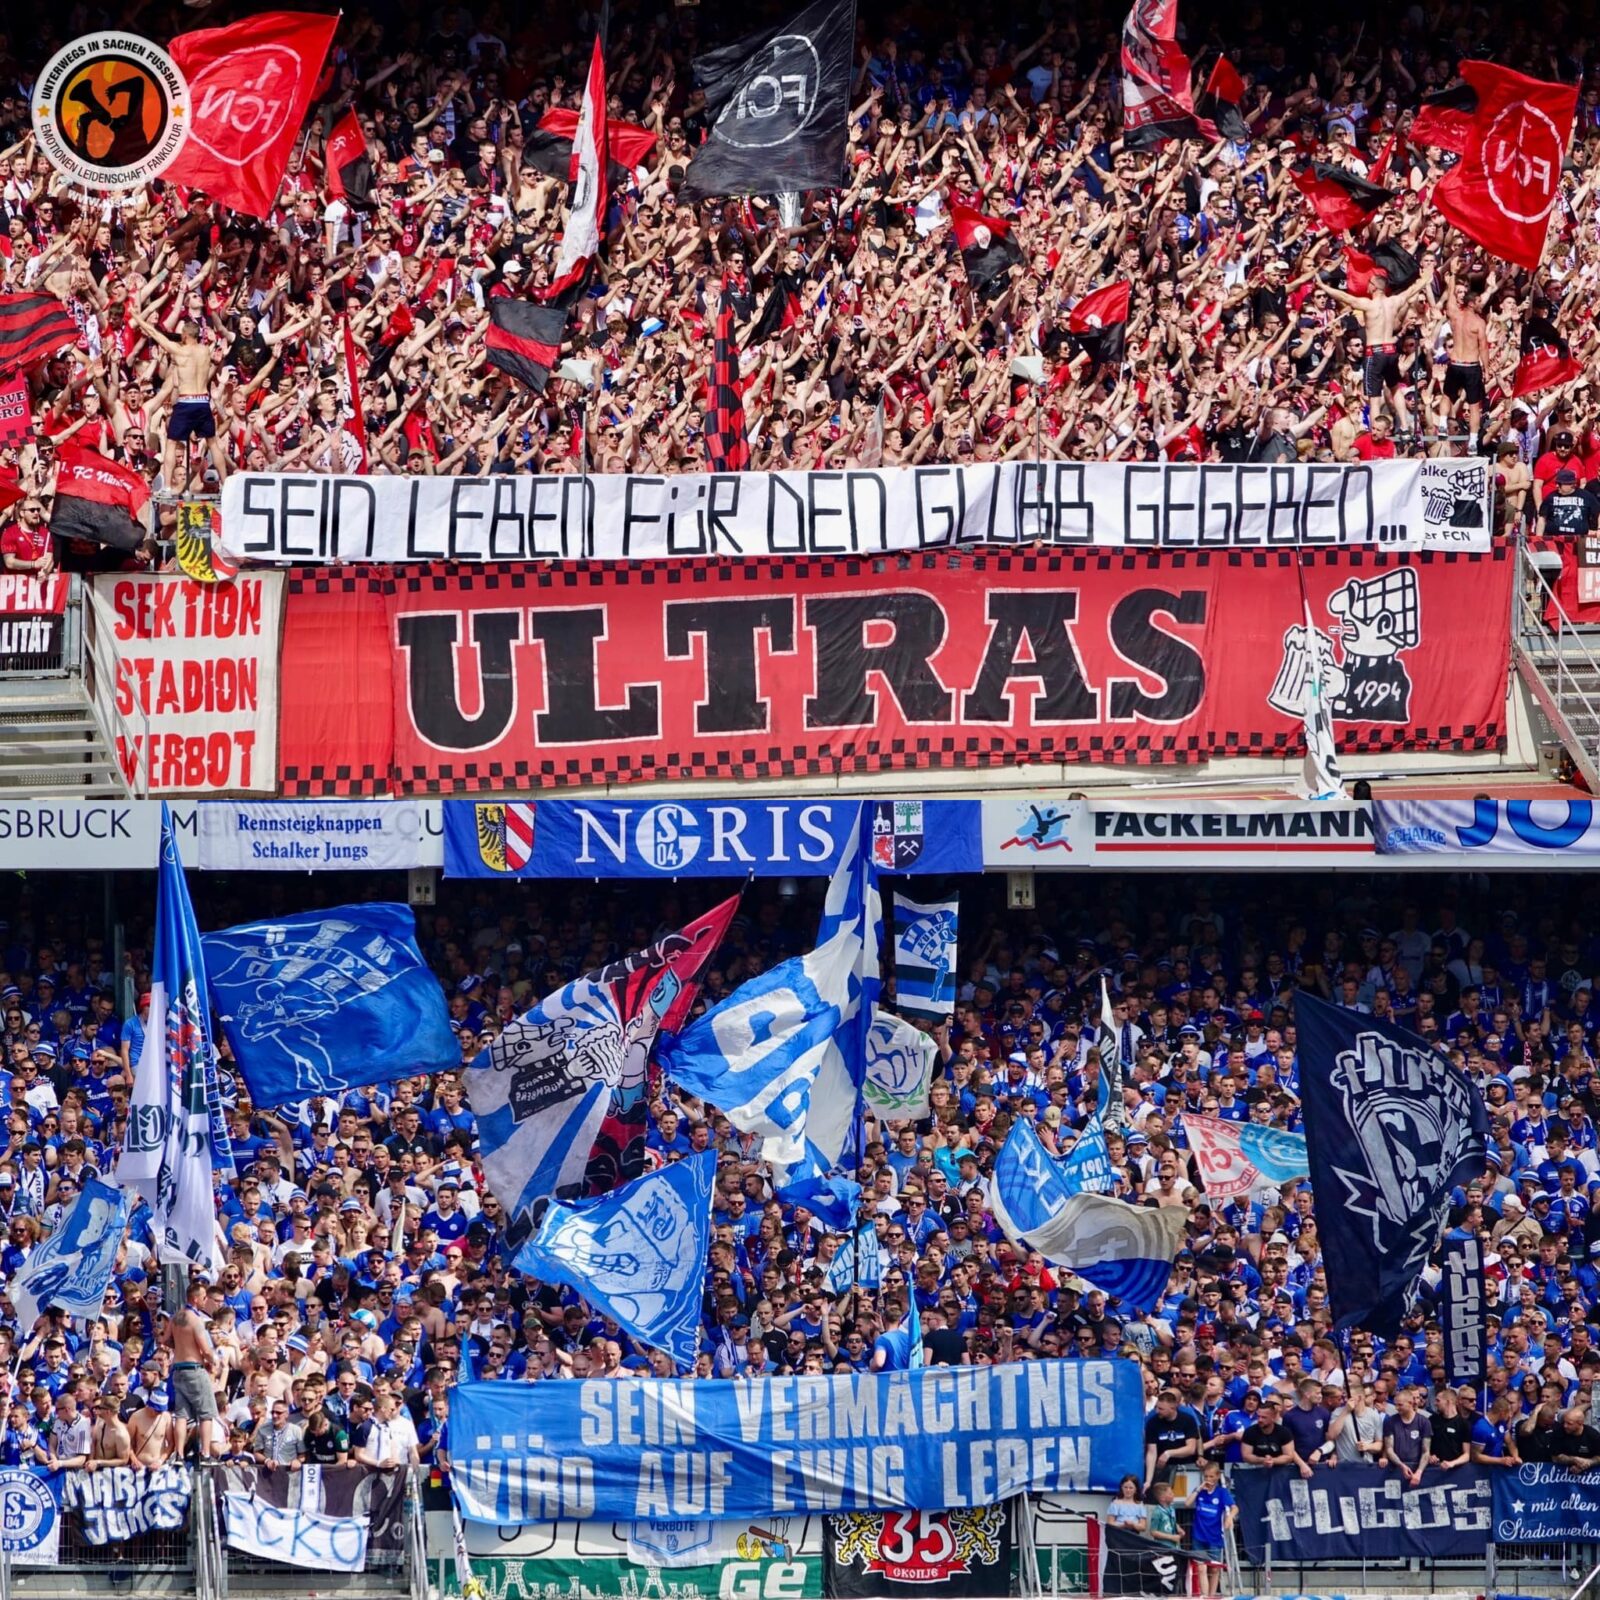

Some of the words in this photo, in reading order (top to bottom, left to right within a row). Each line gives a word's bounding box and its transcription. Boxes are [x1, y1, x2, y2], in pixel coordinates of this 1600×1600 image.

[72, 466, 95, 480] FC
[243, 477, 377, 557] SEIN
[406, 476, 595, 558] LEBEN
[622, 474, 744, 556] FÜR
[766, 469, 888, 555] DEN
[914, 462, 1095, 549] GLUBB
[1442, 530, 1471, 541] FCN
[114, 578, 263, 641] SEKTION
[114, 656, 259, 717] STADION
[394, 586, 1207, 753] ULTRAS
[1353, 680, 1402, 708] 1994
[115, 729, 256, 788] VERBOT
[238, 813, 382, 834] Rennsteigknappen
[1096, 807, 1374, 837] FACKELMANN
[1386, 826, 1447, 846] SCHALKE
[252, 840, 320, 858] Schalker
[323, 841, 369, 862] Jungs
[1444, 1239, 1485, 1377] HUGOS
[580, 1379, 696, 1446] SEIN
[734, 1359, 1116, 1442] VERMÄCHTNIS
[454, 1456, 596, 1520] WIRD
[635, 1451, 734, 1518] AUF
[770, 1444, 905, 1512] EWIG
[1531, 1498, 1557, 1513] mit
[1560, 1492, 1600, 1512] allen
[83, 1491, 188, 1546] JUNGS
[883, 1509, 952, 1564] 35
[1260, 1478, 1492, 1542] HUGOS
